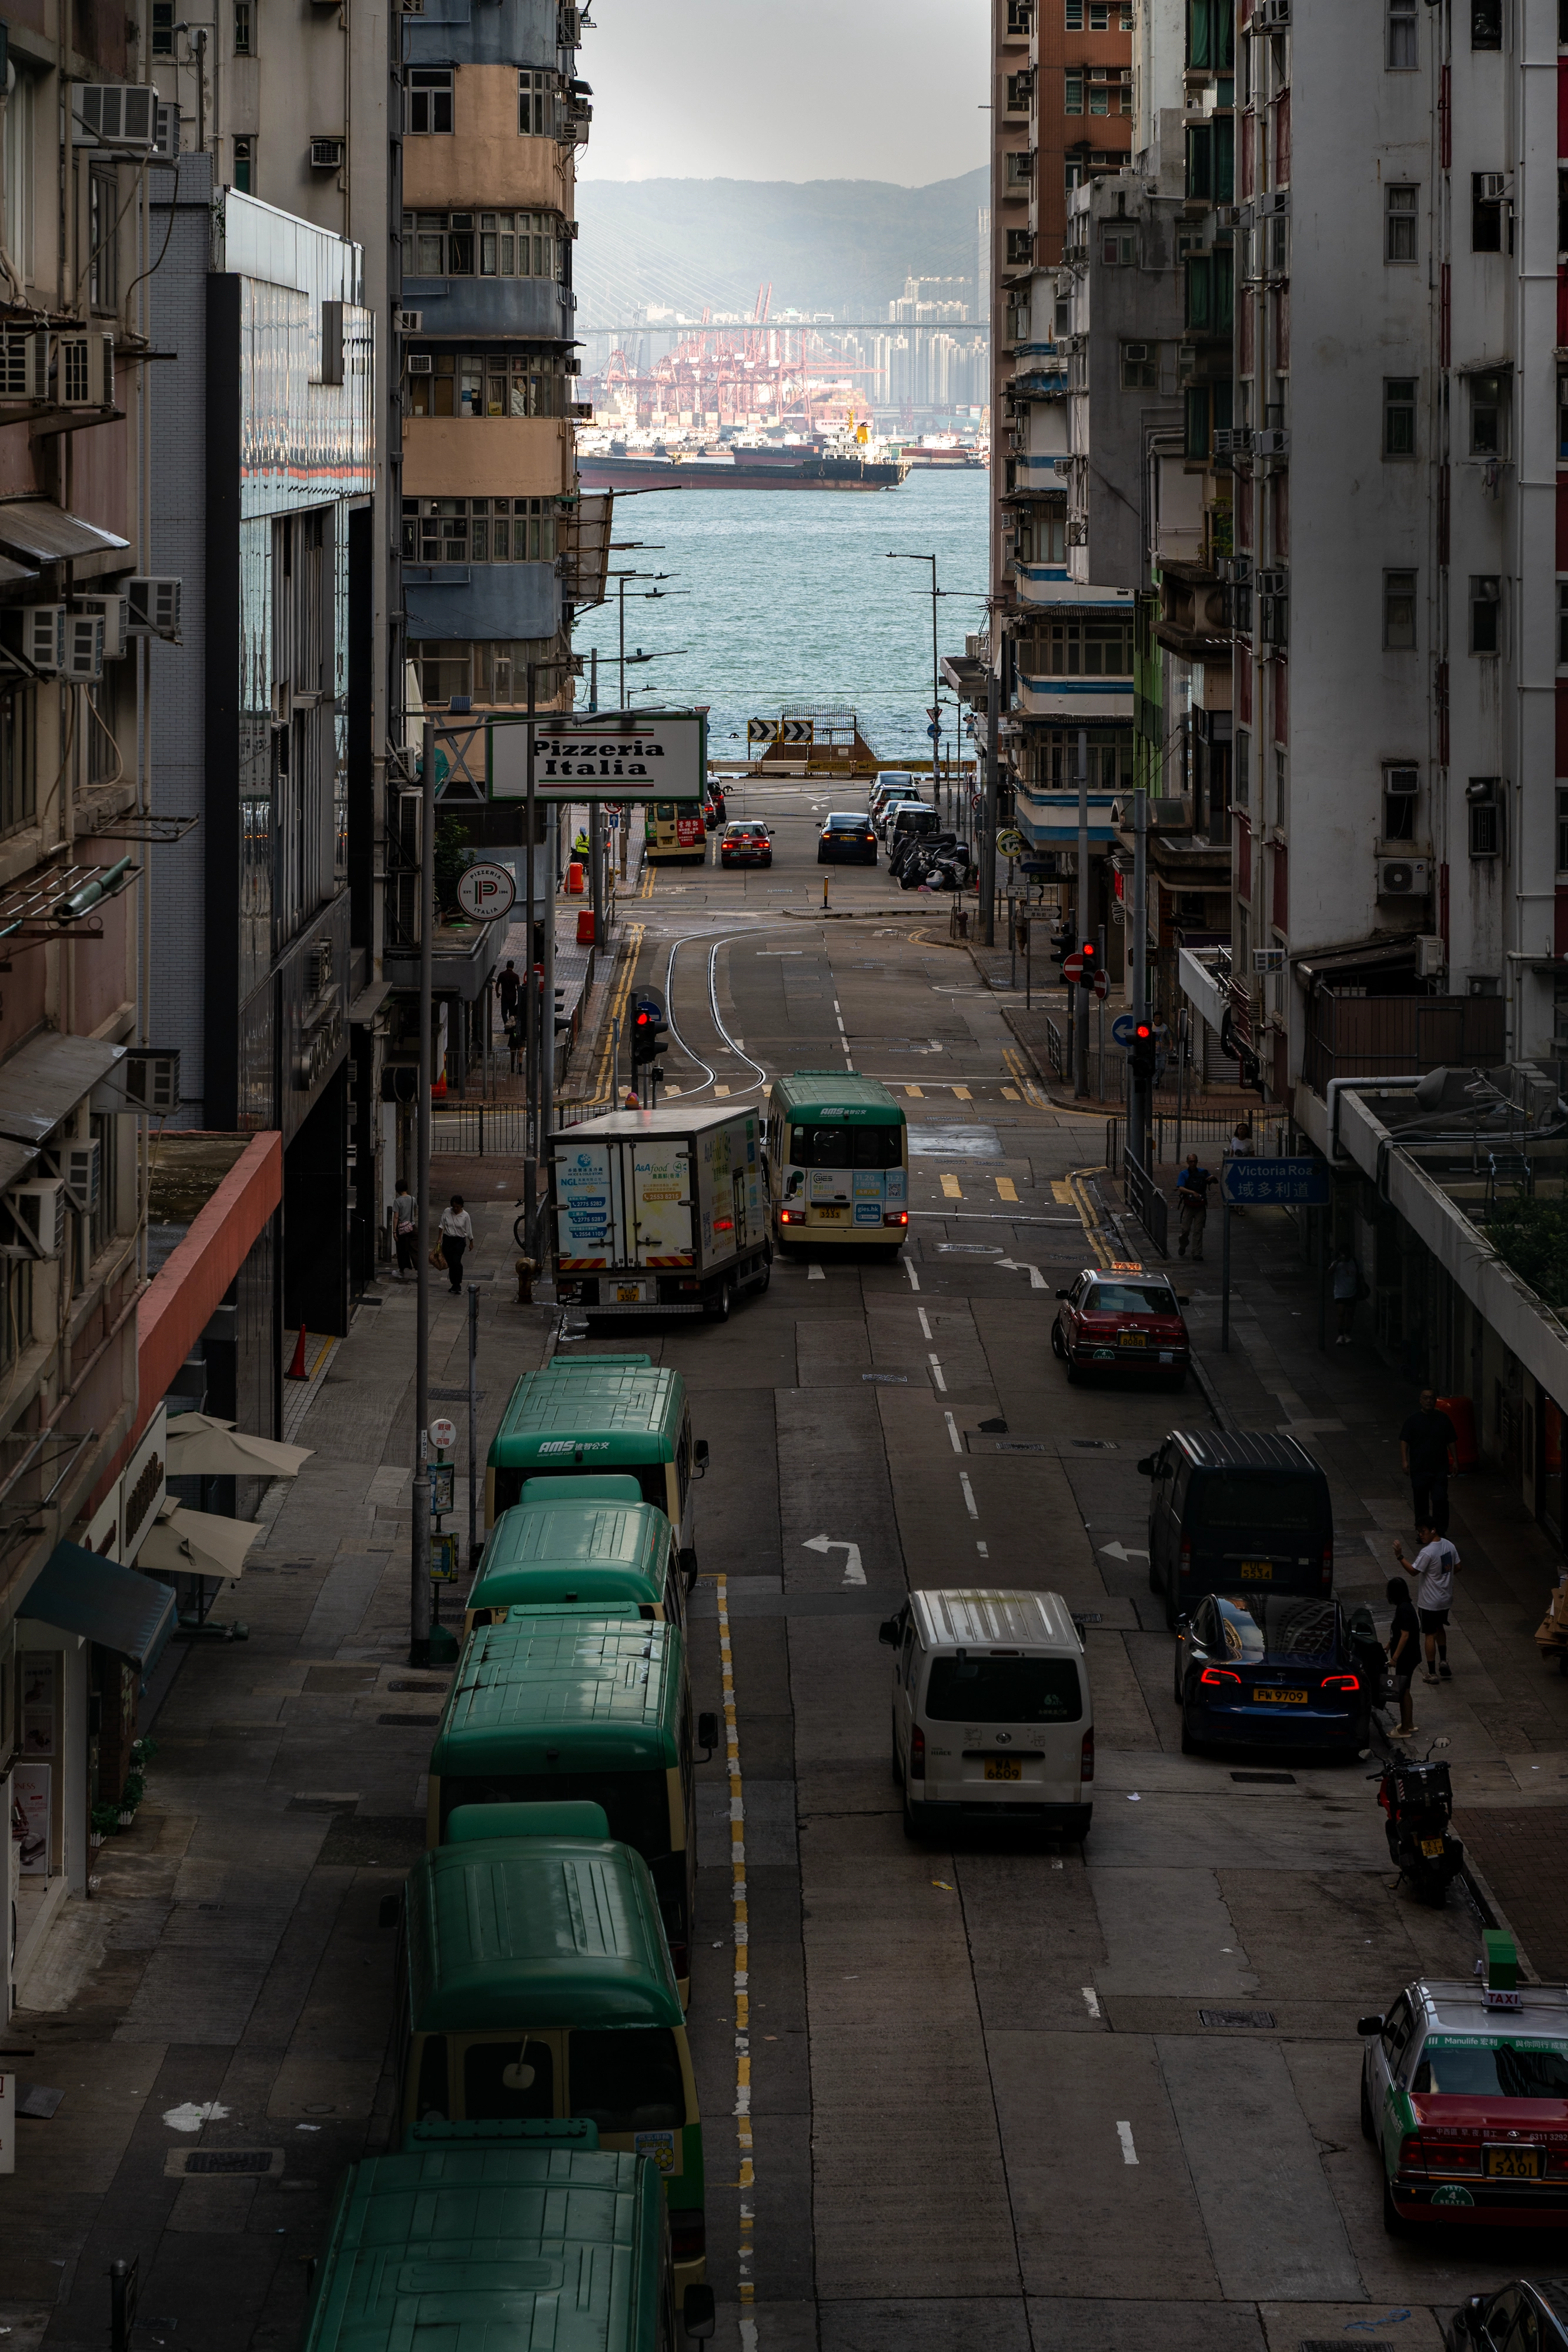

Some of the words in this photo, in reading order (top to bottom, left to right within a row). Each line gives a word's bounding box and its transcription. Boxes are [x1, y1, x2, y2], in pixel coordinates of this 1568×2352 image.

[534, 740, 664, 756] Pizzeria
[546, 760, 647, 775] Italia
[470, 870, 501, 880] PIZZERIA
[1237, 1165, 1286, 1175] Victoria
[1288, 1165, 1317, 1175] Roa
[1238, 1181, 1309, 1198] 域多利道
[538, 1441, 576, 1453] AMS
[575, 1442, 610, 1451] 進智公交
[1250, 1562, 1263, 1570] UL
[1243, 1570, 1270, 1578] 5534
[1258, 1690, 1272, 1699] FW
[1275, 1691, 1303, 1701] 9709
[996, 1759, 1011, 1769] WA
[987, 1769, 1019, 1779] 6609
[1488, 1993, 1518, 2004] TAXI
[1445, 2037, 1479, 2045] Manulife
[1480, 2037, 1498, 2046] 宏利
[1516, 2040, 1549, 2049] 與你同行
[1552, 2042, 1568, 2050] 成就
[1504, 2150, 1523, 2162] XW
[1495, 2162, 1532, 2175] 5401
[1448, 2191, 1457, 2200] 4
